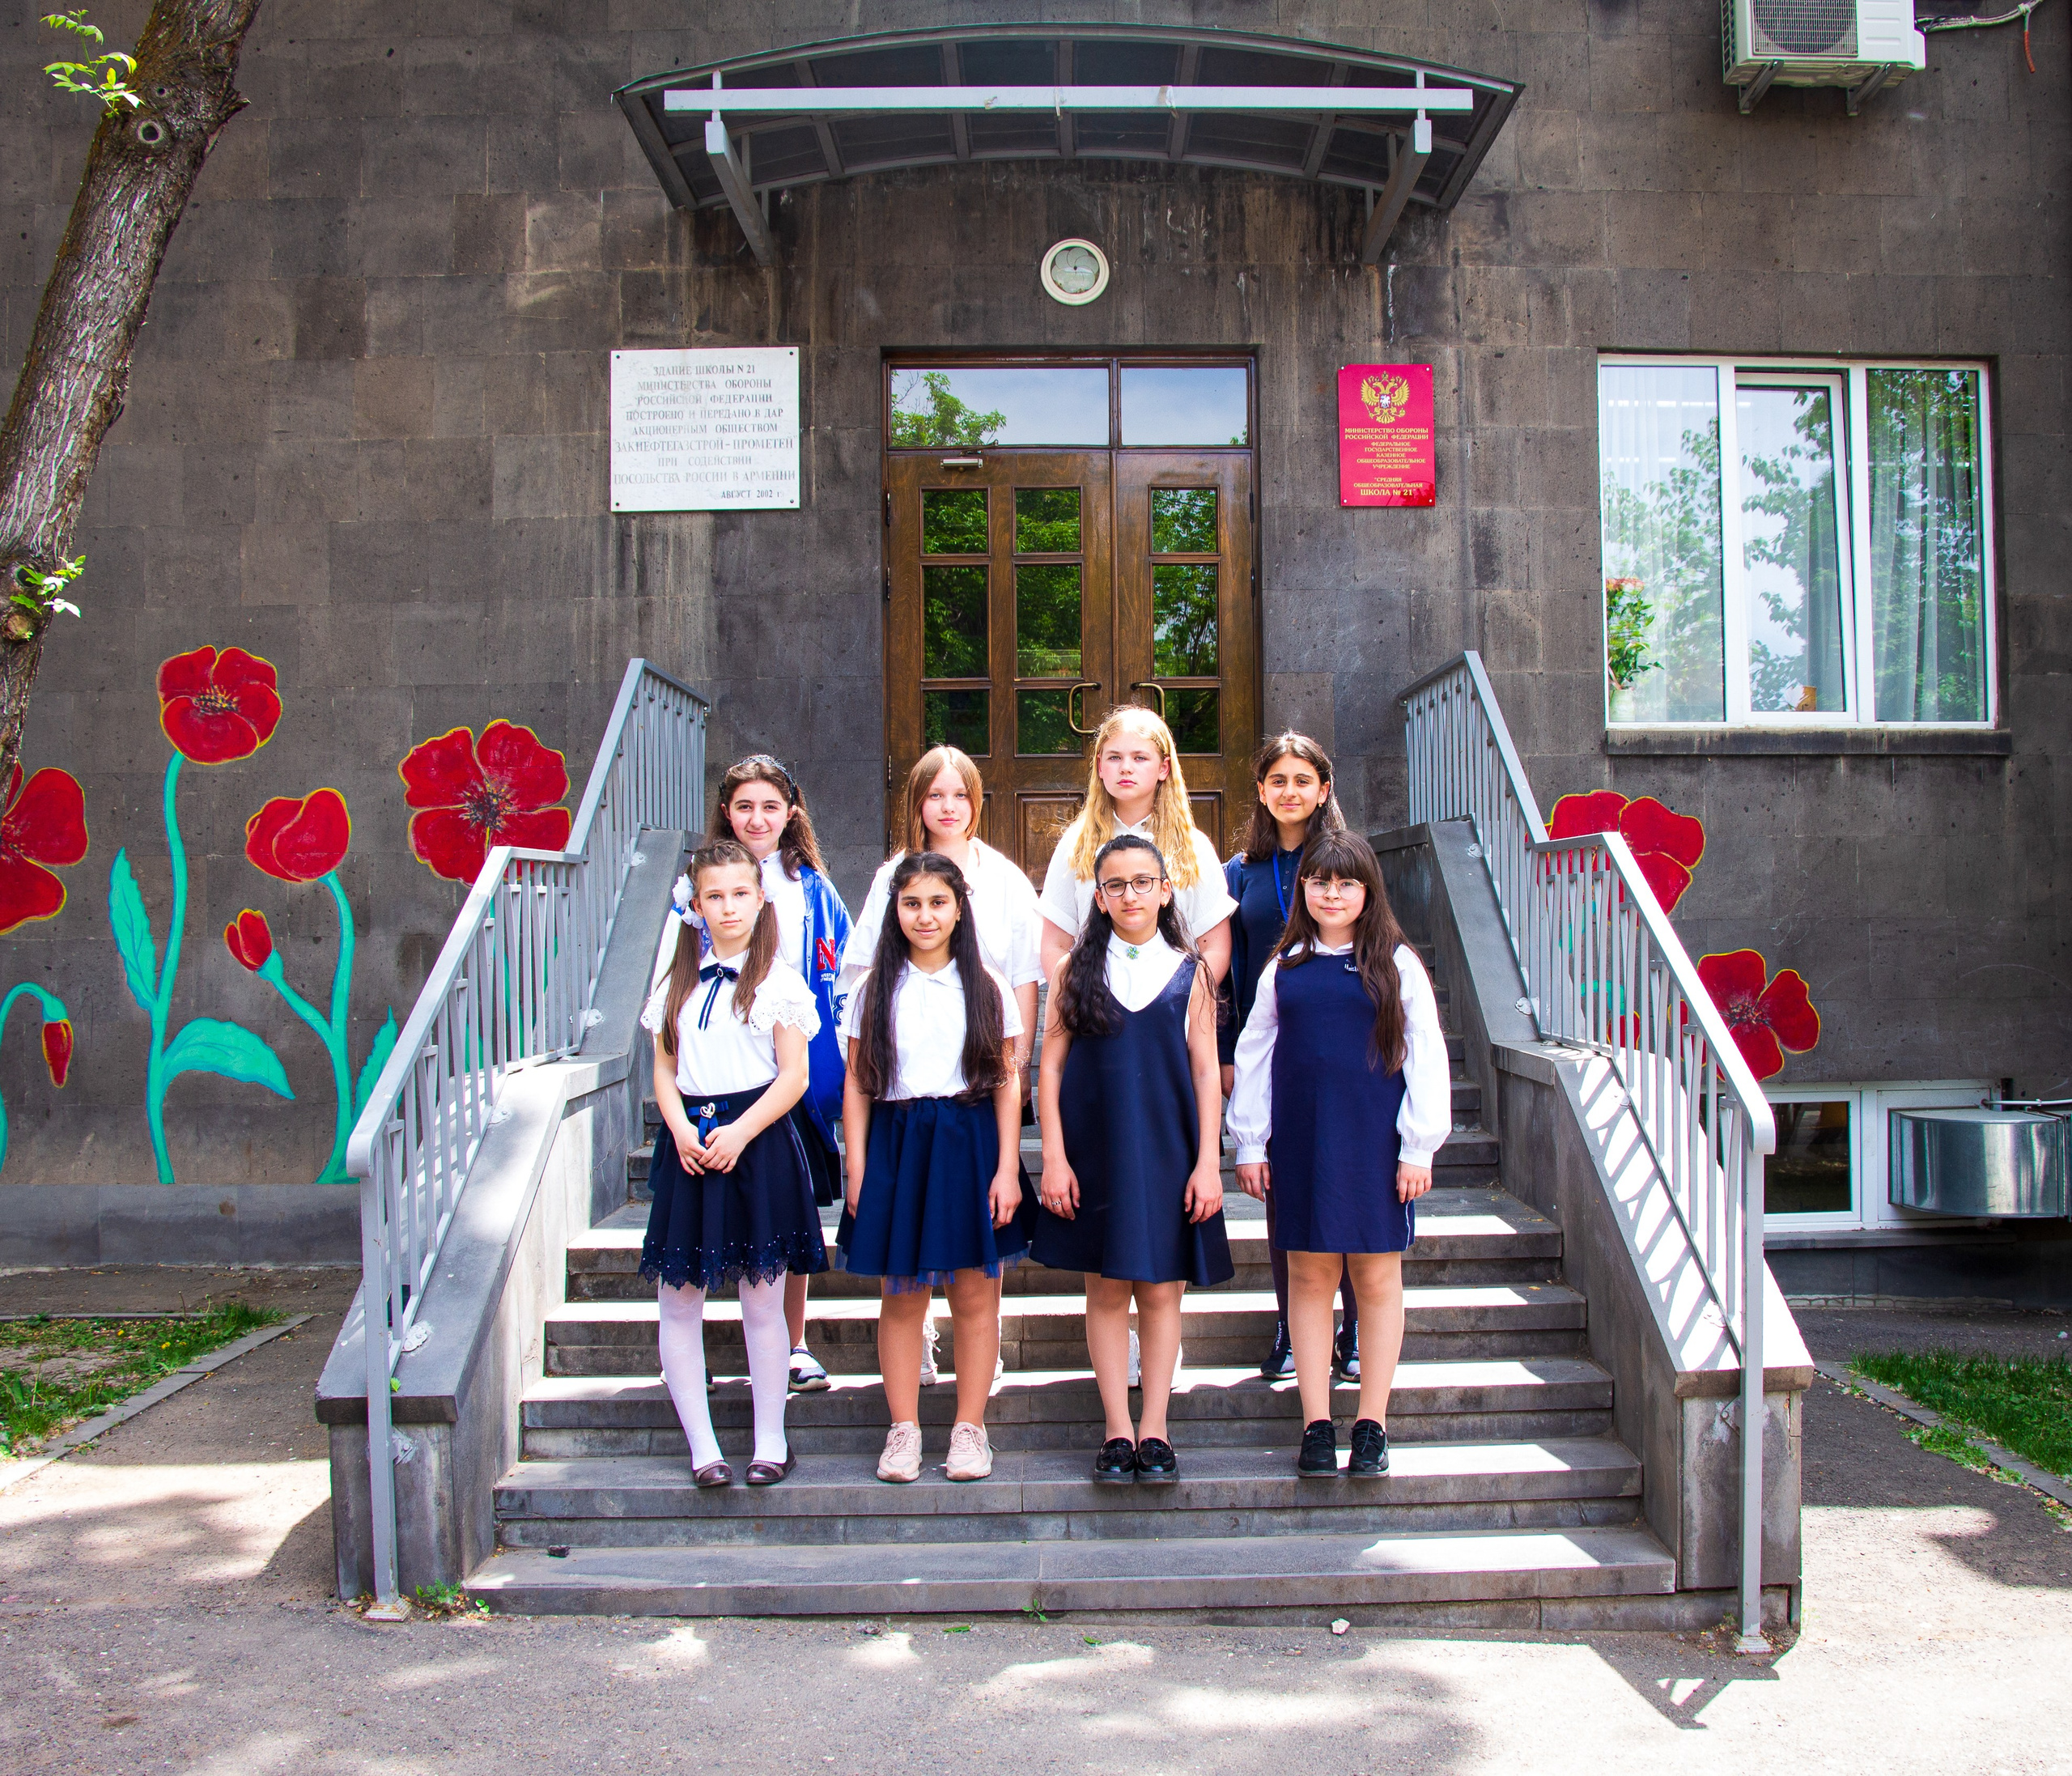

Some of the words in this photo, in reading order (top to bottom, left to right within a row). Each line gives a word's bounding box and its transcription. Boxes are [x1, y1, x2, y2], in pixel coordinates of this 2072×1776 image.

[653, 366, 692, 376] ЗДАНИЕ
[695, 365, 734, 375] ШКОЛЫ
[746, 364, 755, 373] 21
[638, 380, 716, 391] МИНИСТЕРСТВА
[725, 379, 771, 389] ОБОРОНЫ
[637, 393, 702, 406] РОССИЙСКОЙ
[710, 393, 772, 404] ФЕДЕРАЦИИ
[626, 410, 684, 421] ПОСТРОЕНО
[689, 410, 695, 419] И
[700, 409, 751, 419] ПЕРЕДАНО
[754, 409, 761, 418] В
[764, 408, 783, 418] ДАР
[632, 424, 708, 436] АКЦИОНЕРНЫМ
[715, 423, 778, 434] ОБЩЕСТВОМ
[658, 457, 677, 467] ПРИ
[688, 455, 752, 467] СОДЕЙСТВИИ
[614, 472, 681, 485] ПОСОЛЬСТВА
[686, 471, 727, 482] РОССИИ
[732, 471, 738, 481] В
[743, 469, 796, 481] АРМЕНИИ
[721, 490, 751, 499] АВГУСТ
[757, 489, 773, 498] 2002
